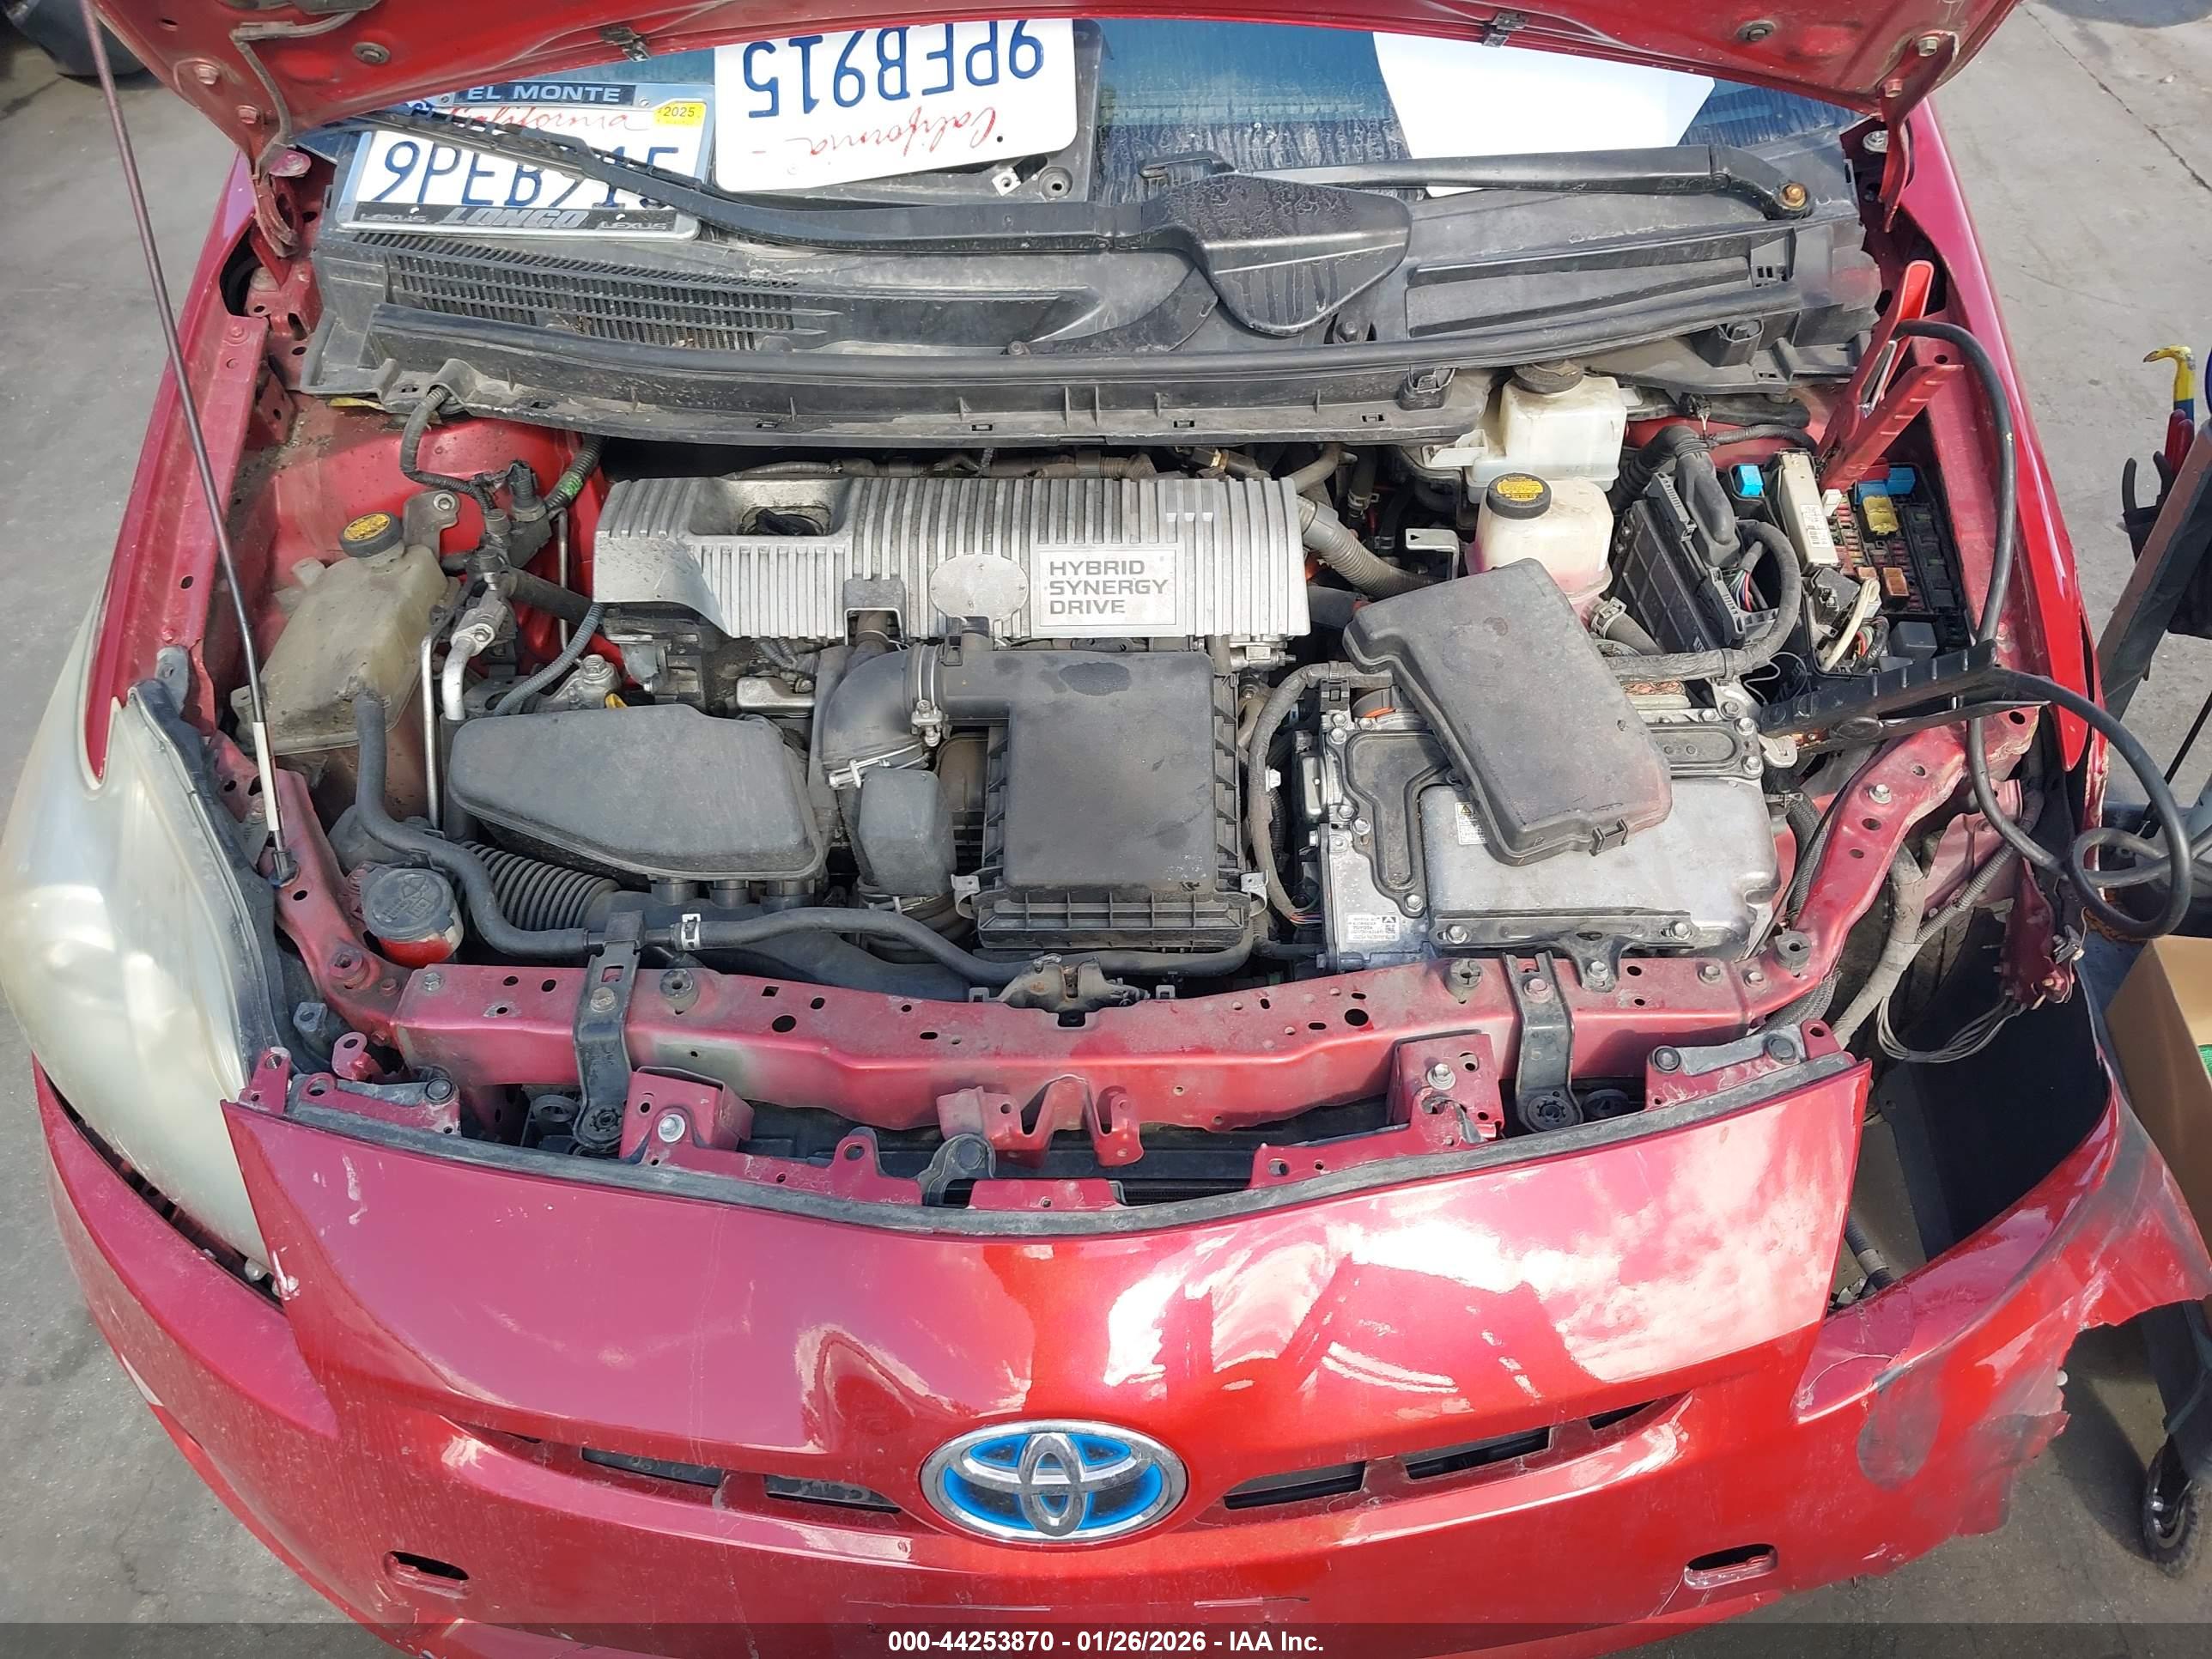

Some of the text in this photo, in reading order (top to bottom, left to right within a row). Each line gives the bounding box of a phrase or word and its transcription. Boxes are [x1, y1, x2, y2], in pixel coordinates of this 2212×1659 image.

[742, 19, 1044, 118] 9PEB915
[467, 85, 621, 103] EL MONTE
[663, 106, 696, 118] 2025
[785, 106, 997, 158] California
[435, 206, 591, 229] LONGO
[597, 221, 667, 231] LEXUS
[1049, 560, 1146, 576] HYBRID
[1049, 579, 1169, 596] SYNERGY
[1049, 599, 1127, 615] DRIVE
